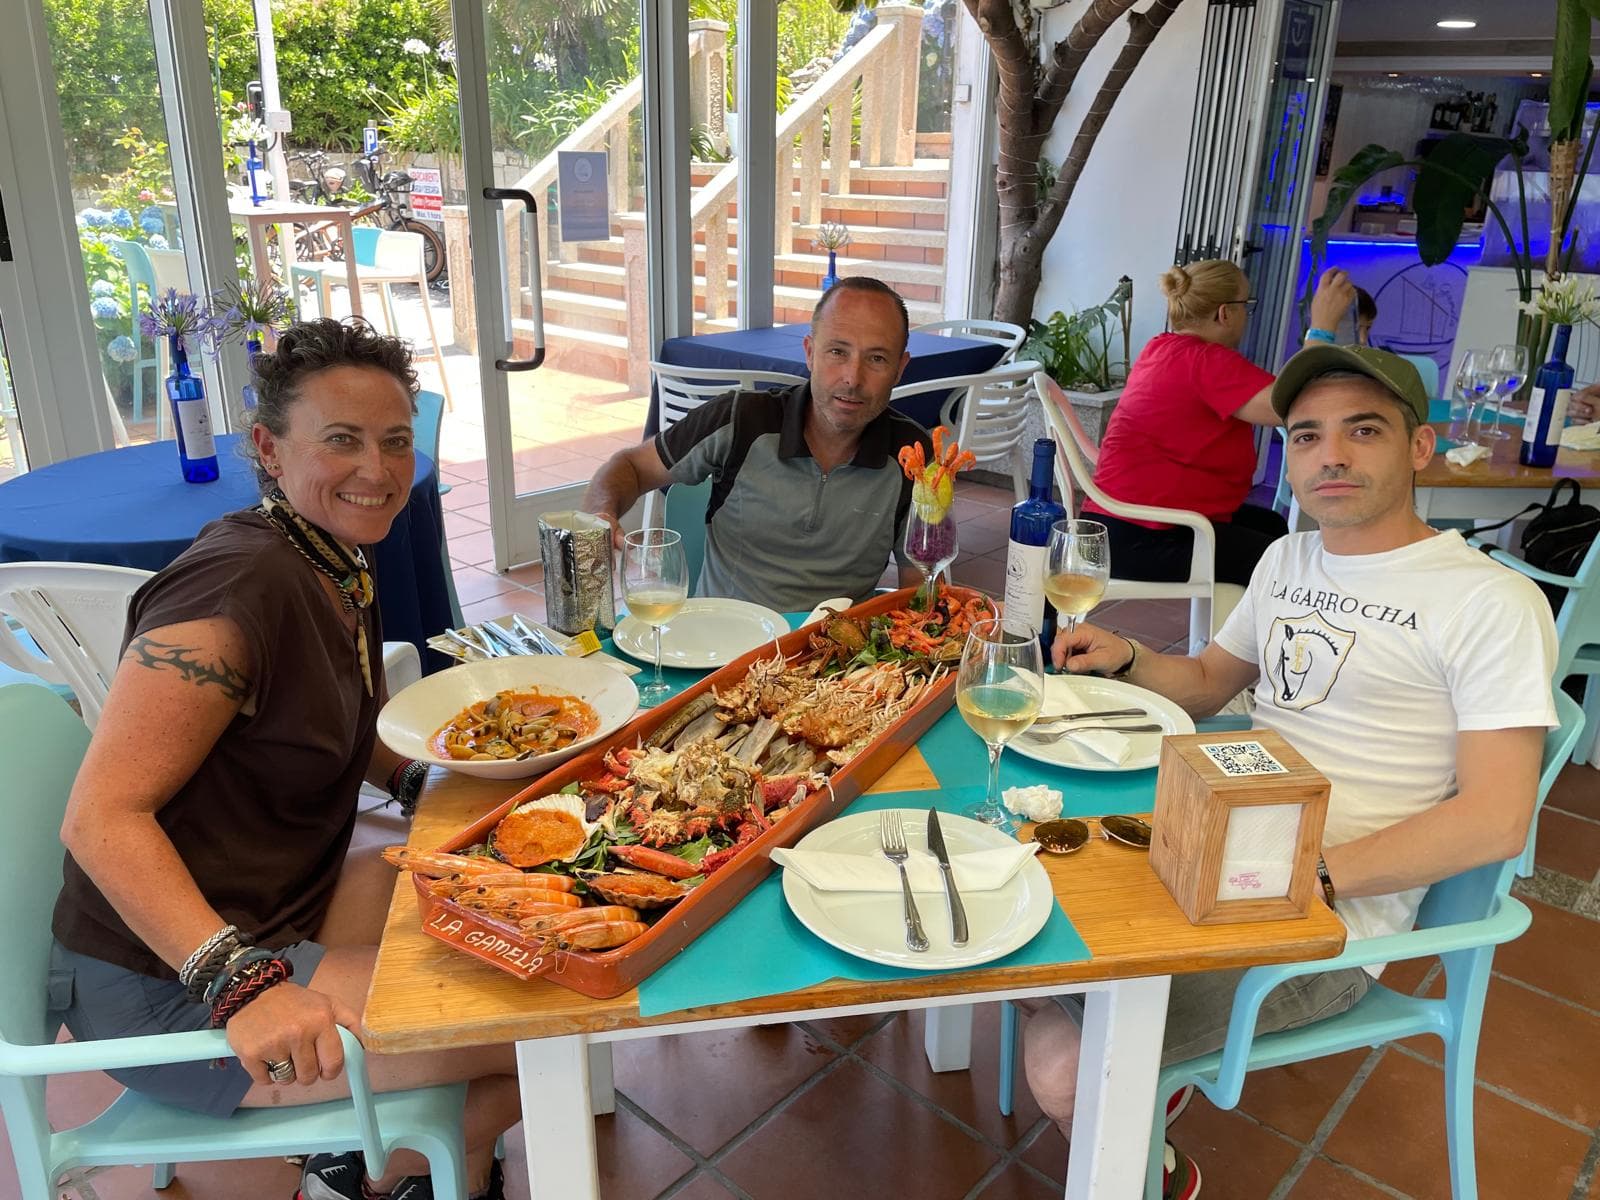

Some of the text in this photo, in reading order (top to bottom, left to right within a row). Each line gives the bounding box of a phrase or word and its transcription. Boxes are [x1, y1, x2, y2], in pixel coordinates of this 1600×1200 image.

[366, 130, 375, 151] P
[1270, 581, 1418, 631] LA GARROCHA
[430, 913, 543, 973] LA GAMELA
